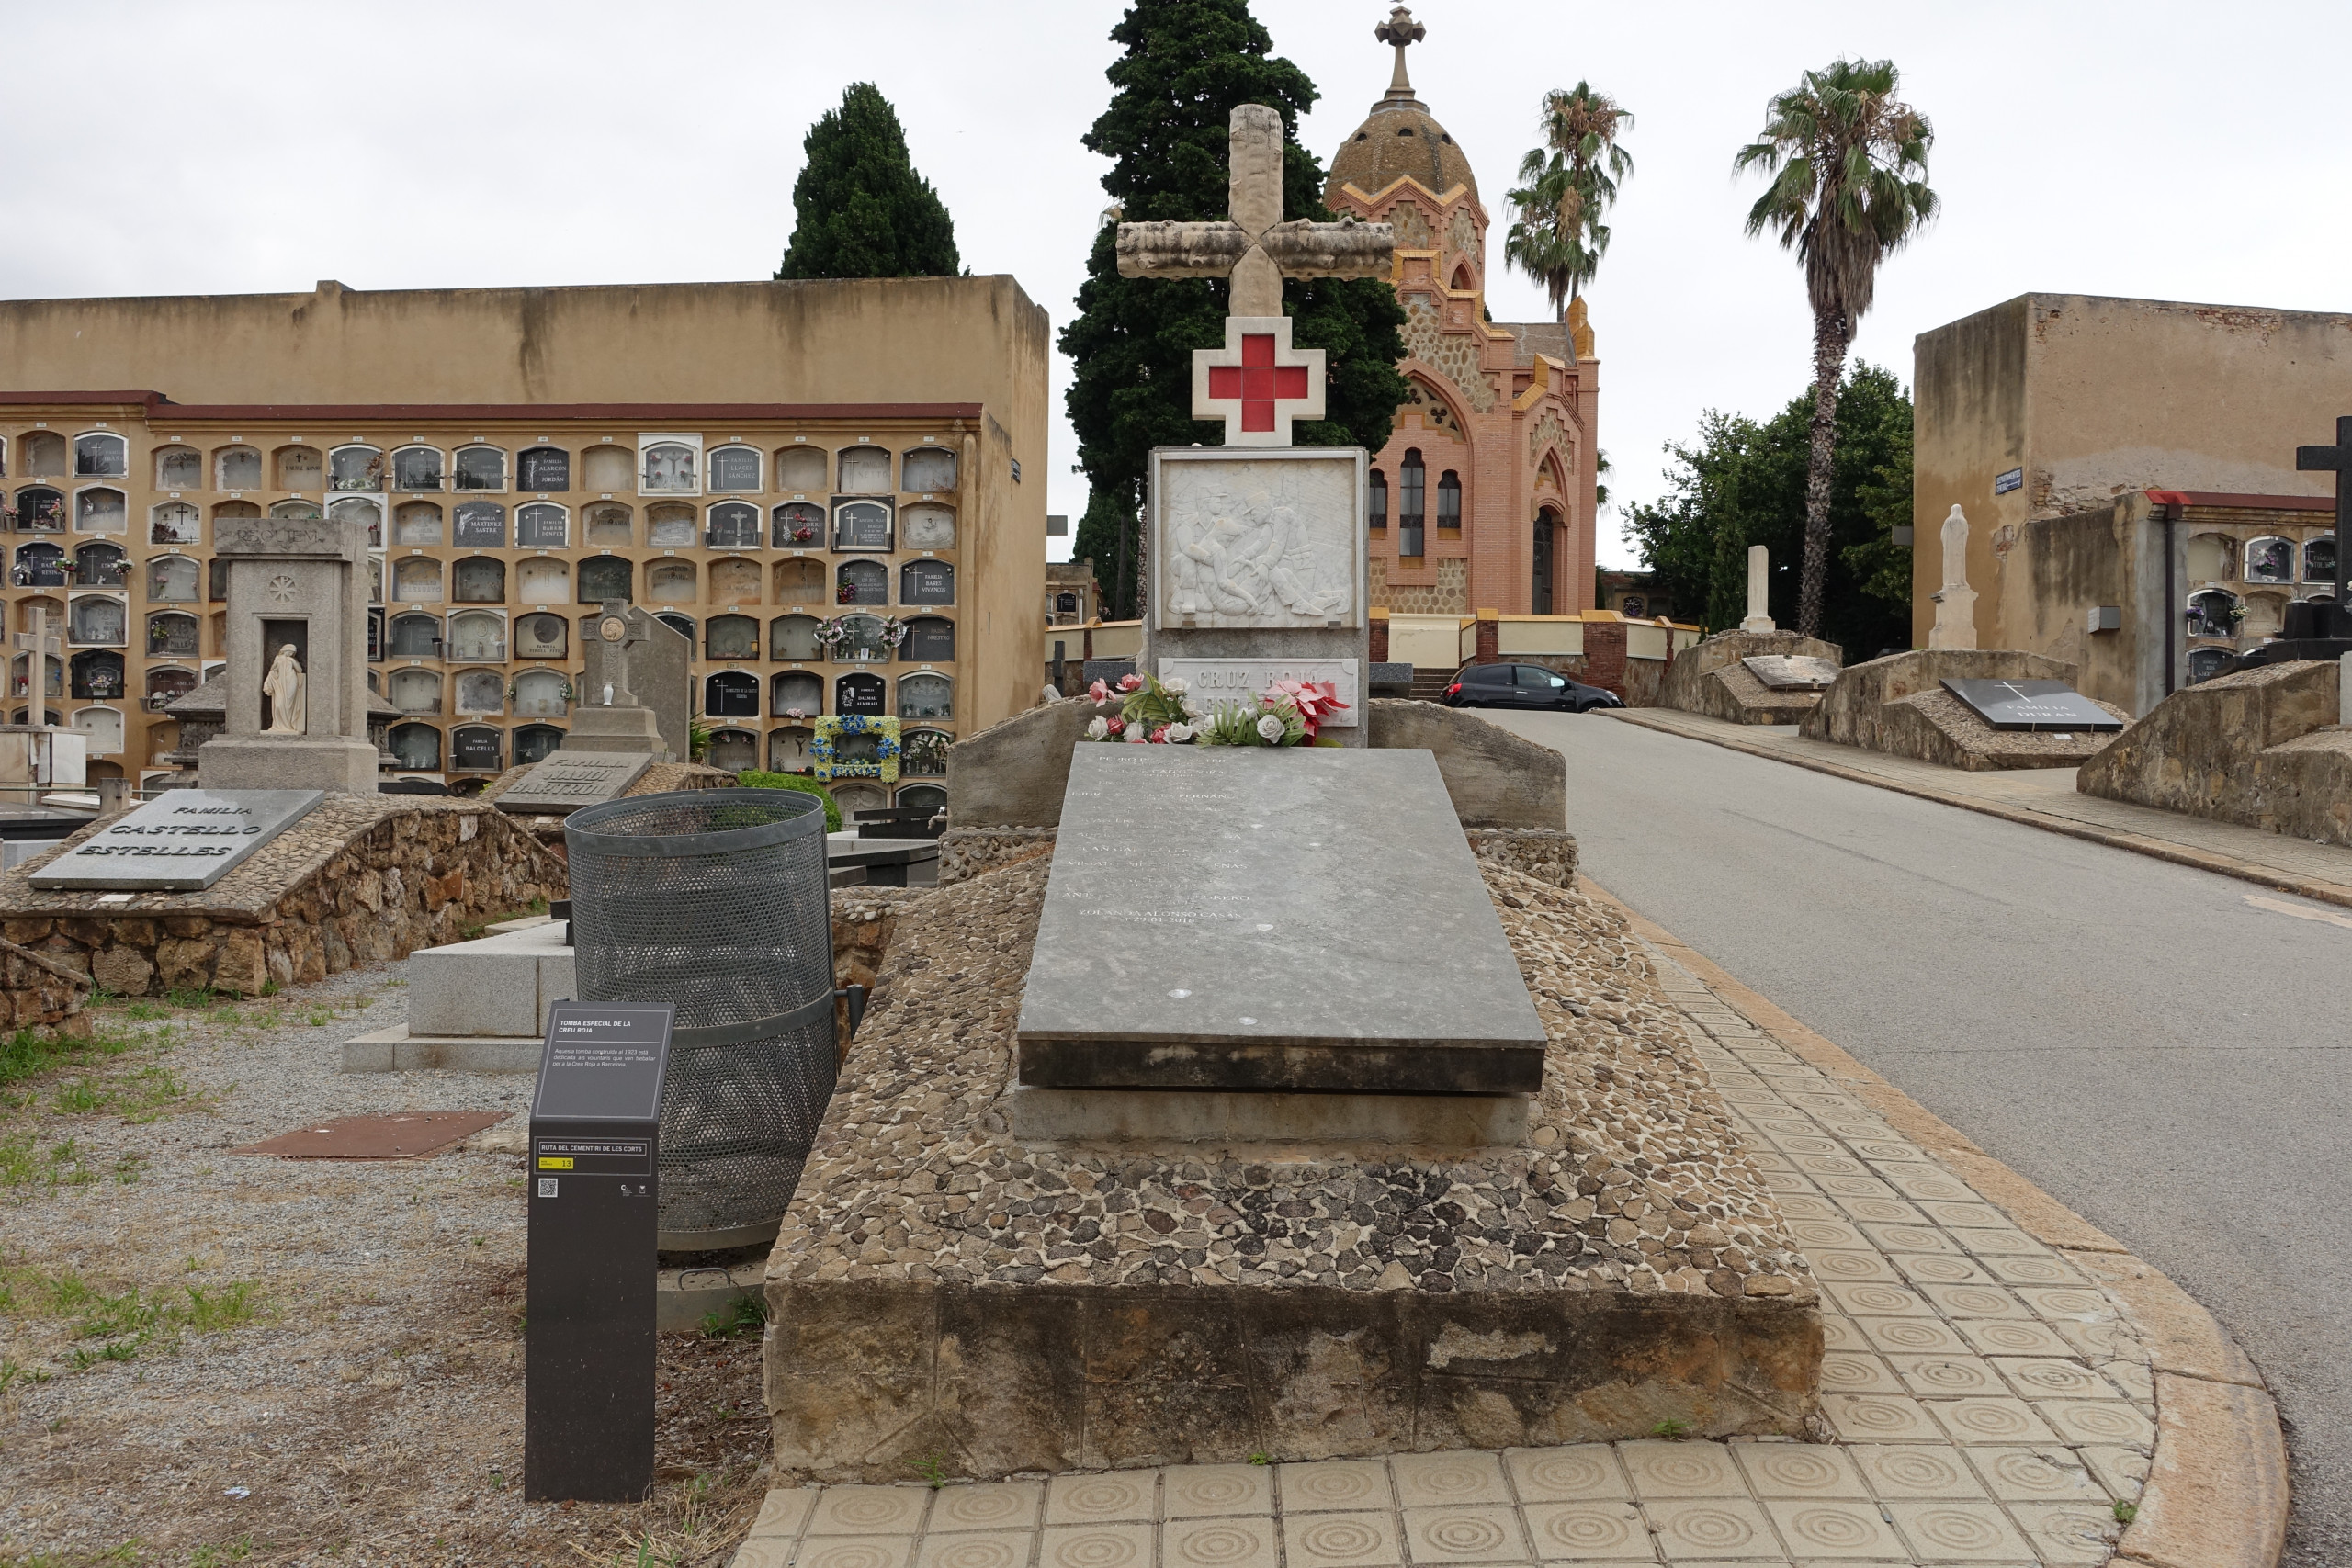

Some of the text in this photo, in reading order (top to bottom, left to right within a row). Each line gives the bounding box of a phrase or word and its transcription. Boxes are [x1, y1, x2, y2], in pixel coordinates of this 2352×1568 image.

[1197, 670, 1250, 689] CRUZ
[549, 759, 630, 768] FAMILIA
[109, 825, 262, 835] CASTELLO
[75, 845, 232, 856] ESTELLES
